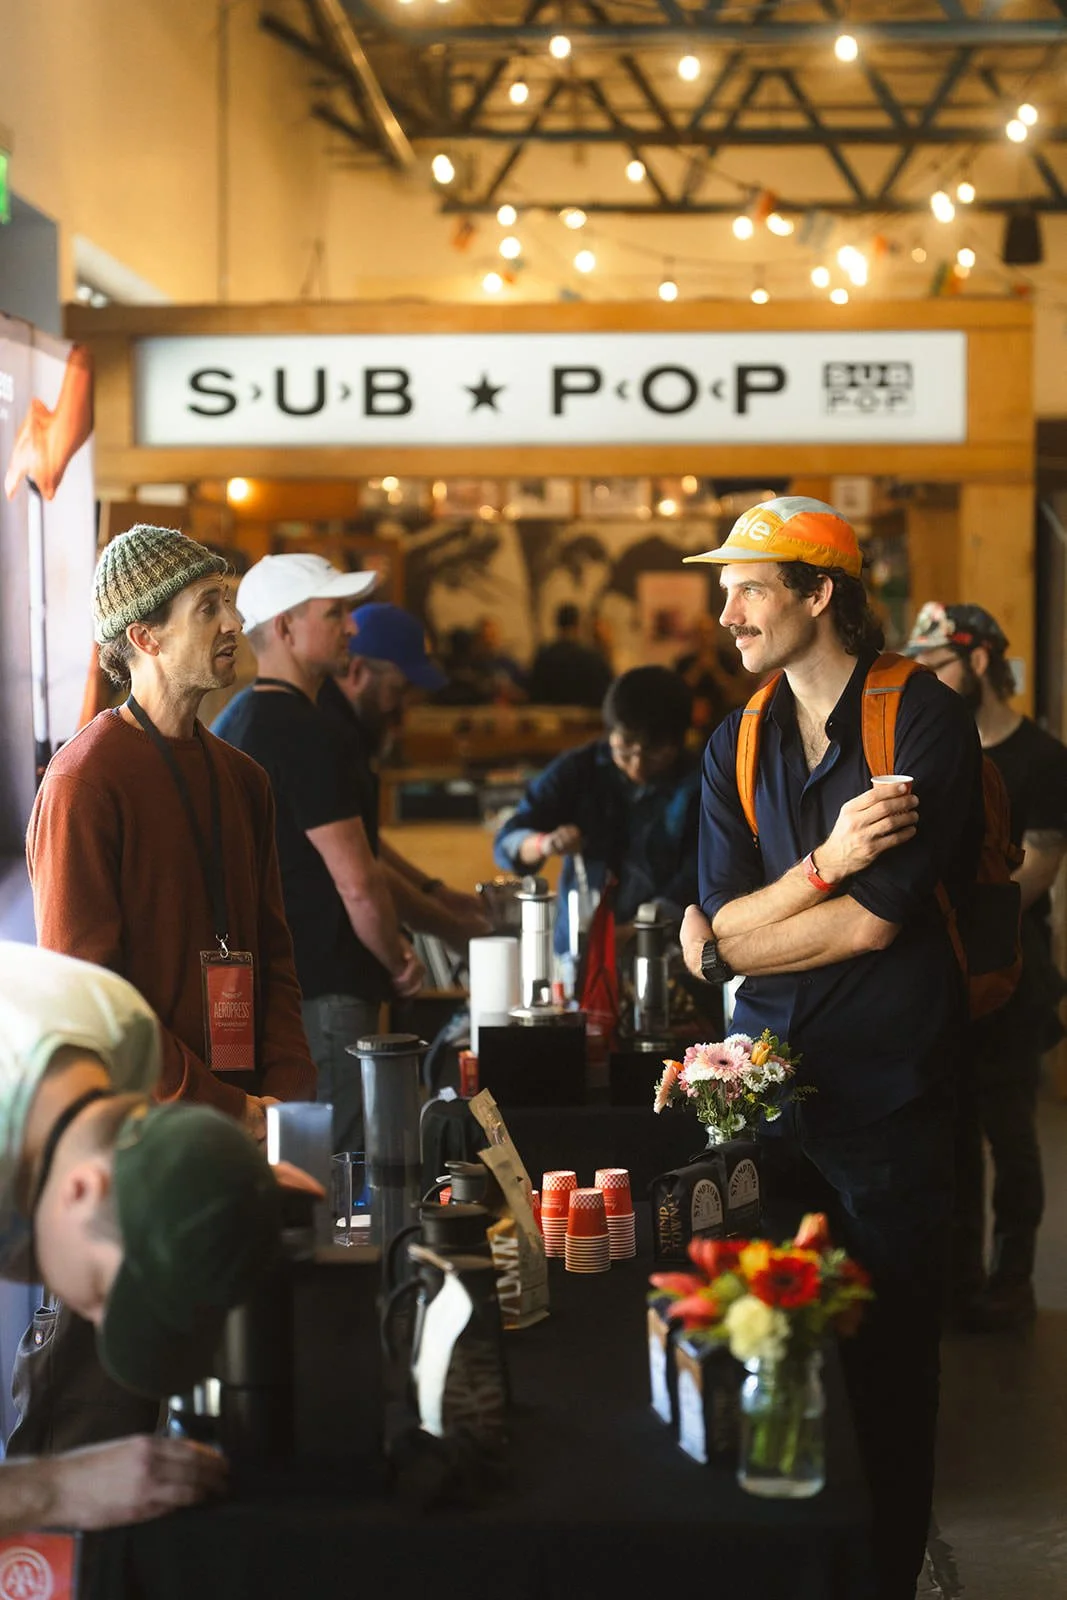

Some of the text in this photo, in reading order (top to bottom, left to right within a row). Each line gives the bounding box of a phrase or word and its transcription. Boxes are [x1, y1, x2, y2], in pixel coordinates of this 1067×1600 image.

[829, 365, 911, 386] SUB
[829, 389, 909, 414] POP
[214, 1002, 250, 1018] AEROPRESS
